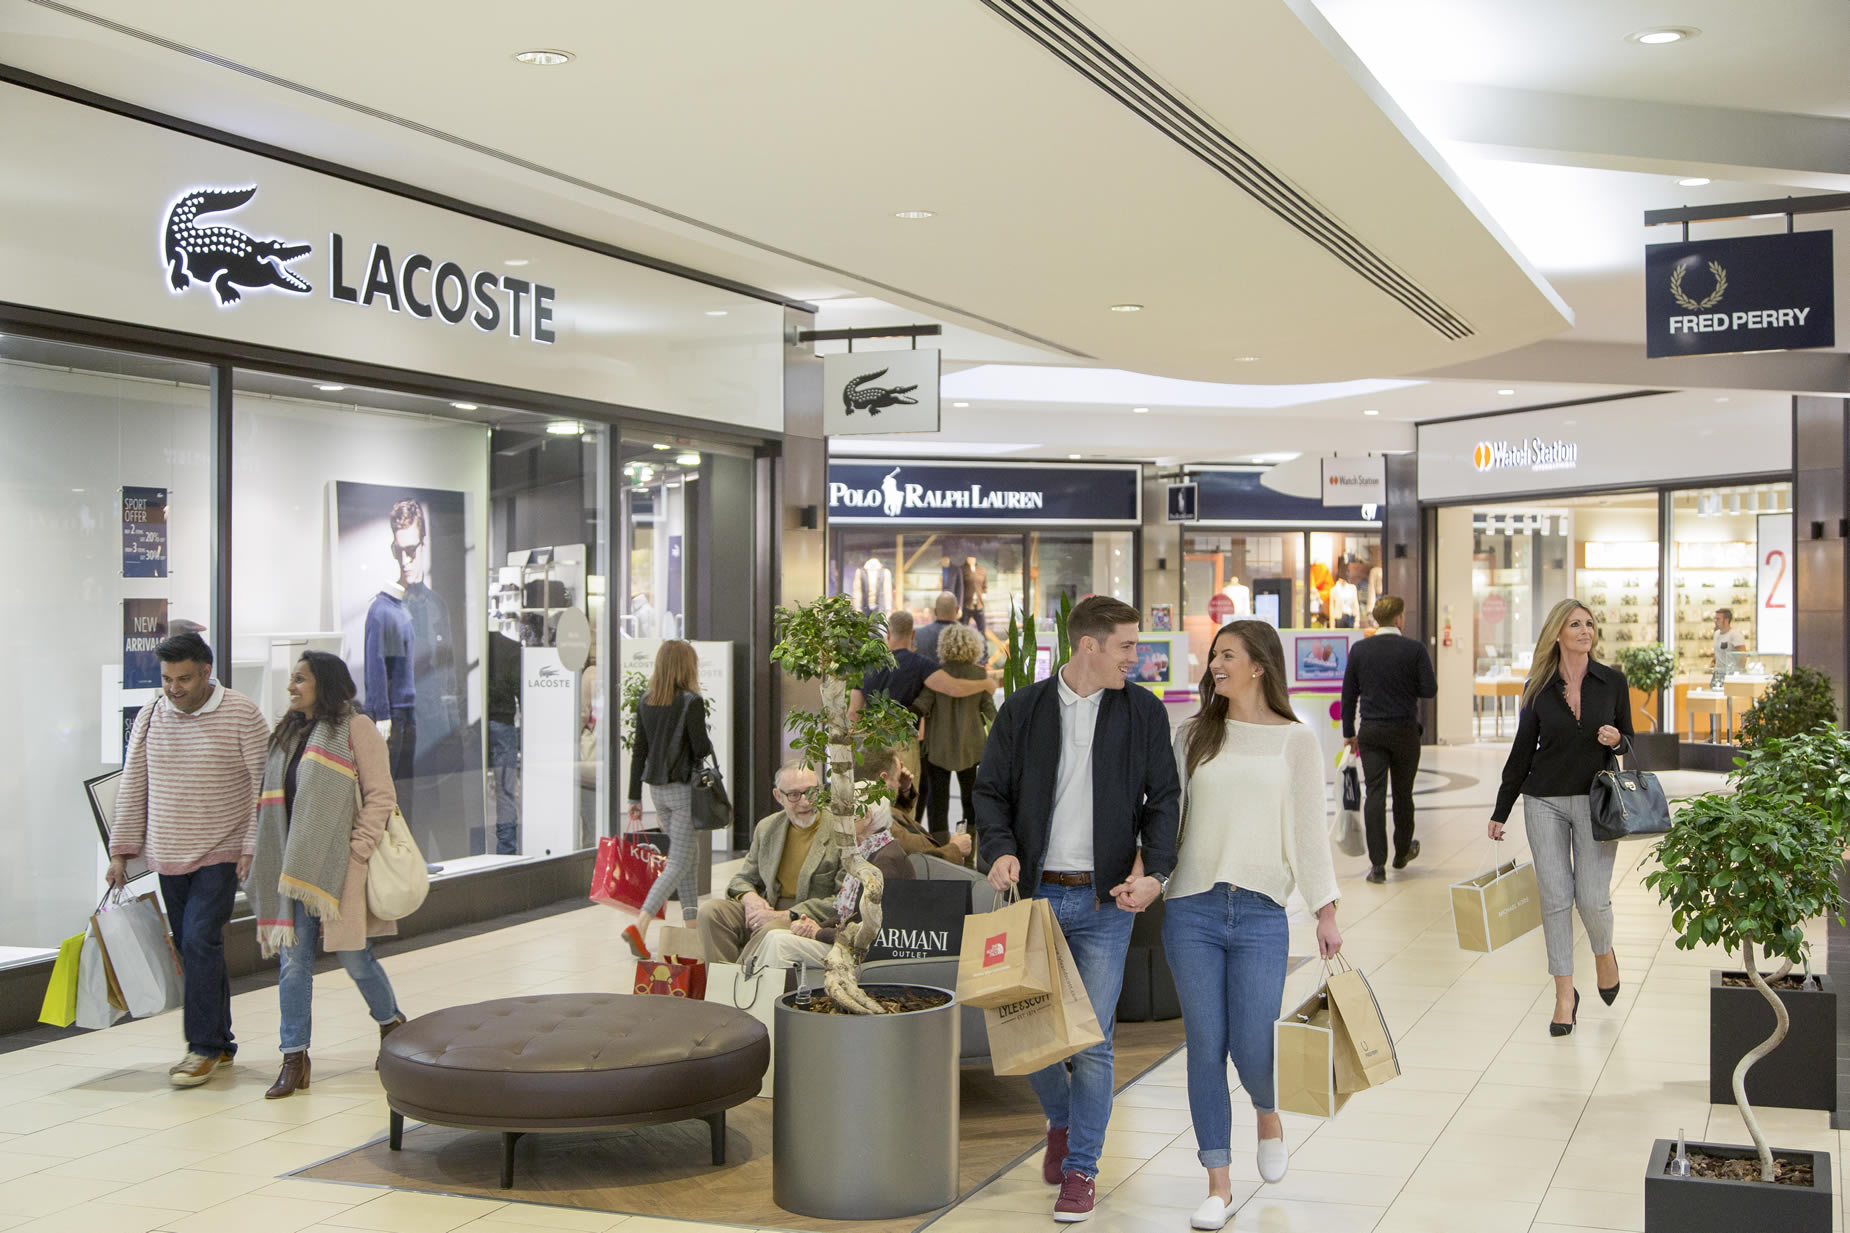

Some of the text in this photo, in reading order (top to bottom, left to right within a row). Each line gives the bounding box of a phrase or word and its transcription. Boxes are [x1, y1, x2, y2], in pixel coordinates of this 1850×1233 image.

[329, 232, 556, 344] LACOSTE
[1669, 307, 1810, 334] FRED PERRY
[1494, 436, 1577, 469] Watch Station
[904, 483, 970, 509] RALPH
[971, 484, 1043, 509] LAUREN
[124, 498, 147, 510] SPORT
[124, 510, 147, 522] OFFER
[130, 524, 136, 535] 2
[132, 542, 138, 553] 3
[1765, 549, 1786, 608] 2
[134, 617, 157, 632] NEW
[623, 661, 654, 669] LACOST
[528, 679, 570, 688] LACOSTE
[630, 845, 667, 868] KUR
[874, 928, 949, 951] ARMANI
[892, 950, 928, 959] OUTLET
